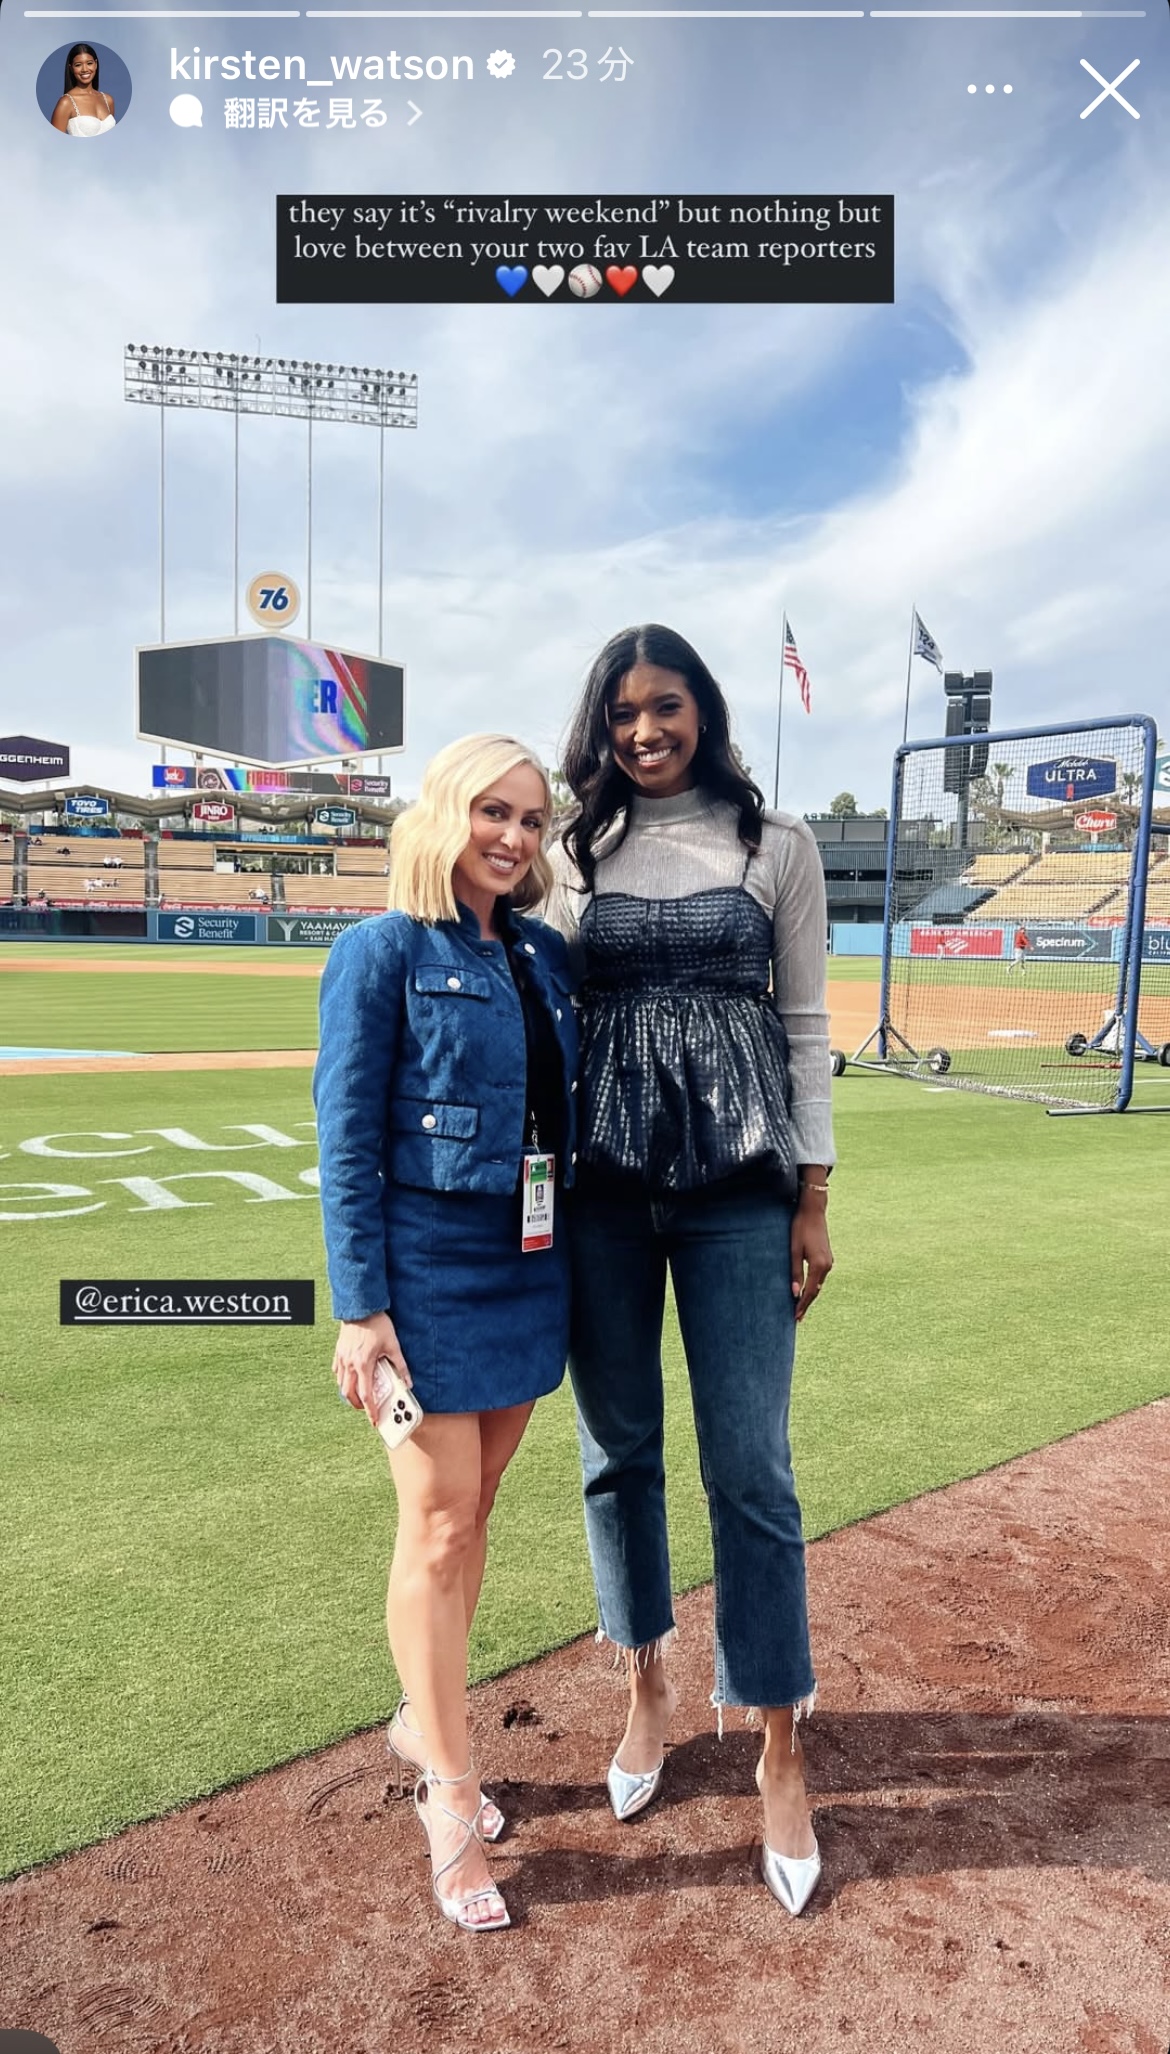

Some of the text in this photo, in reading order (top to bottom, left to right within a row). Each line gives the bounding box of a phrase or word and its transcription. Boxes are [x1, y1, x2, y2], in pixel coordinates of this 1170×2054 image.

[259, 587, 289, 611] 76
[1045, 768, 1097, 783] ULTRA
[200, 804, 228, 817] JINRO
[198, 917, 240, 930] Security
[198, 928, 234, 939] Benefit
[1036, 936, 1085, 950] Spectrum
